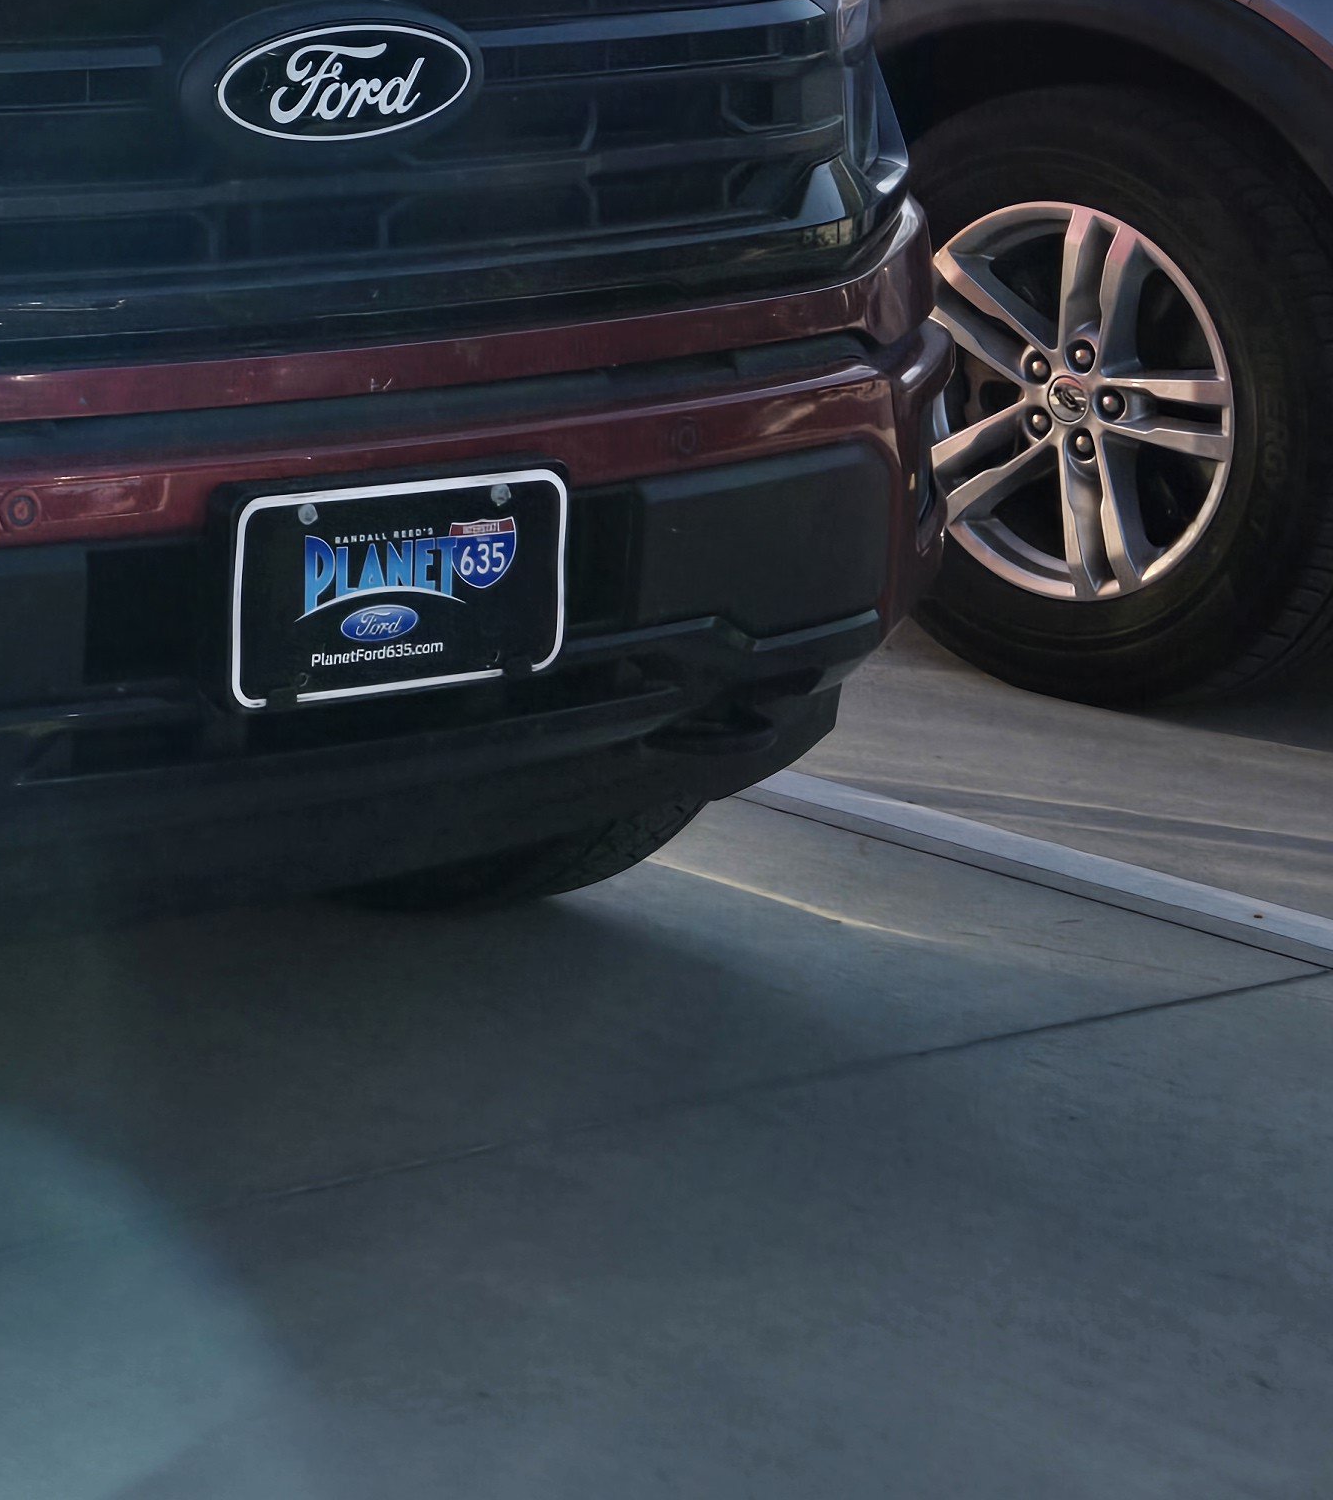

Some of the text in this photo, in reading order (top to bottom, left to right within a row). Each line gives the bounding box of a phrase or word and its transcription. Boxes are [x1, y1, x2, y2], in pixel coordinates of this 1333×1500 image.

[269, 42, 425, 124] Ford
[335, 527, 434, 544] RANDALL REED'S
[460, 542, 506, 576] 635
[304, 534, 458, 617] PLANET
[356, 611, 403, 636] Ford
[311, 641, 444, 667] PlanetFord635.com
